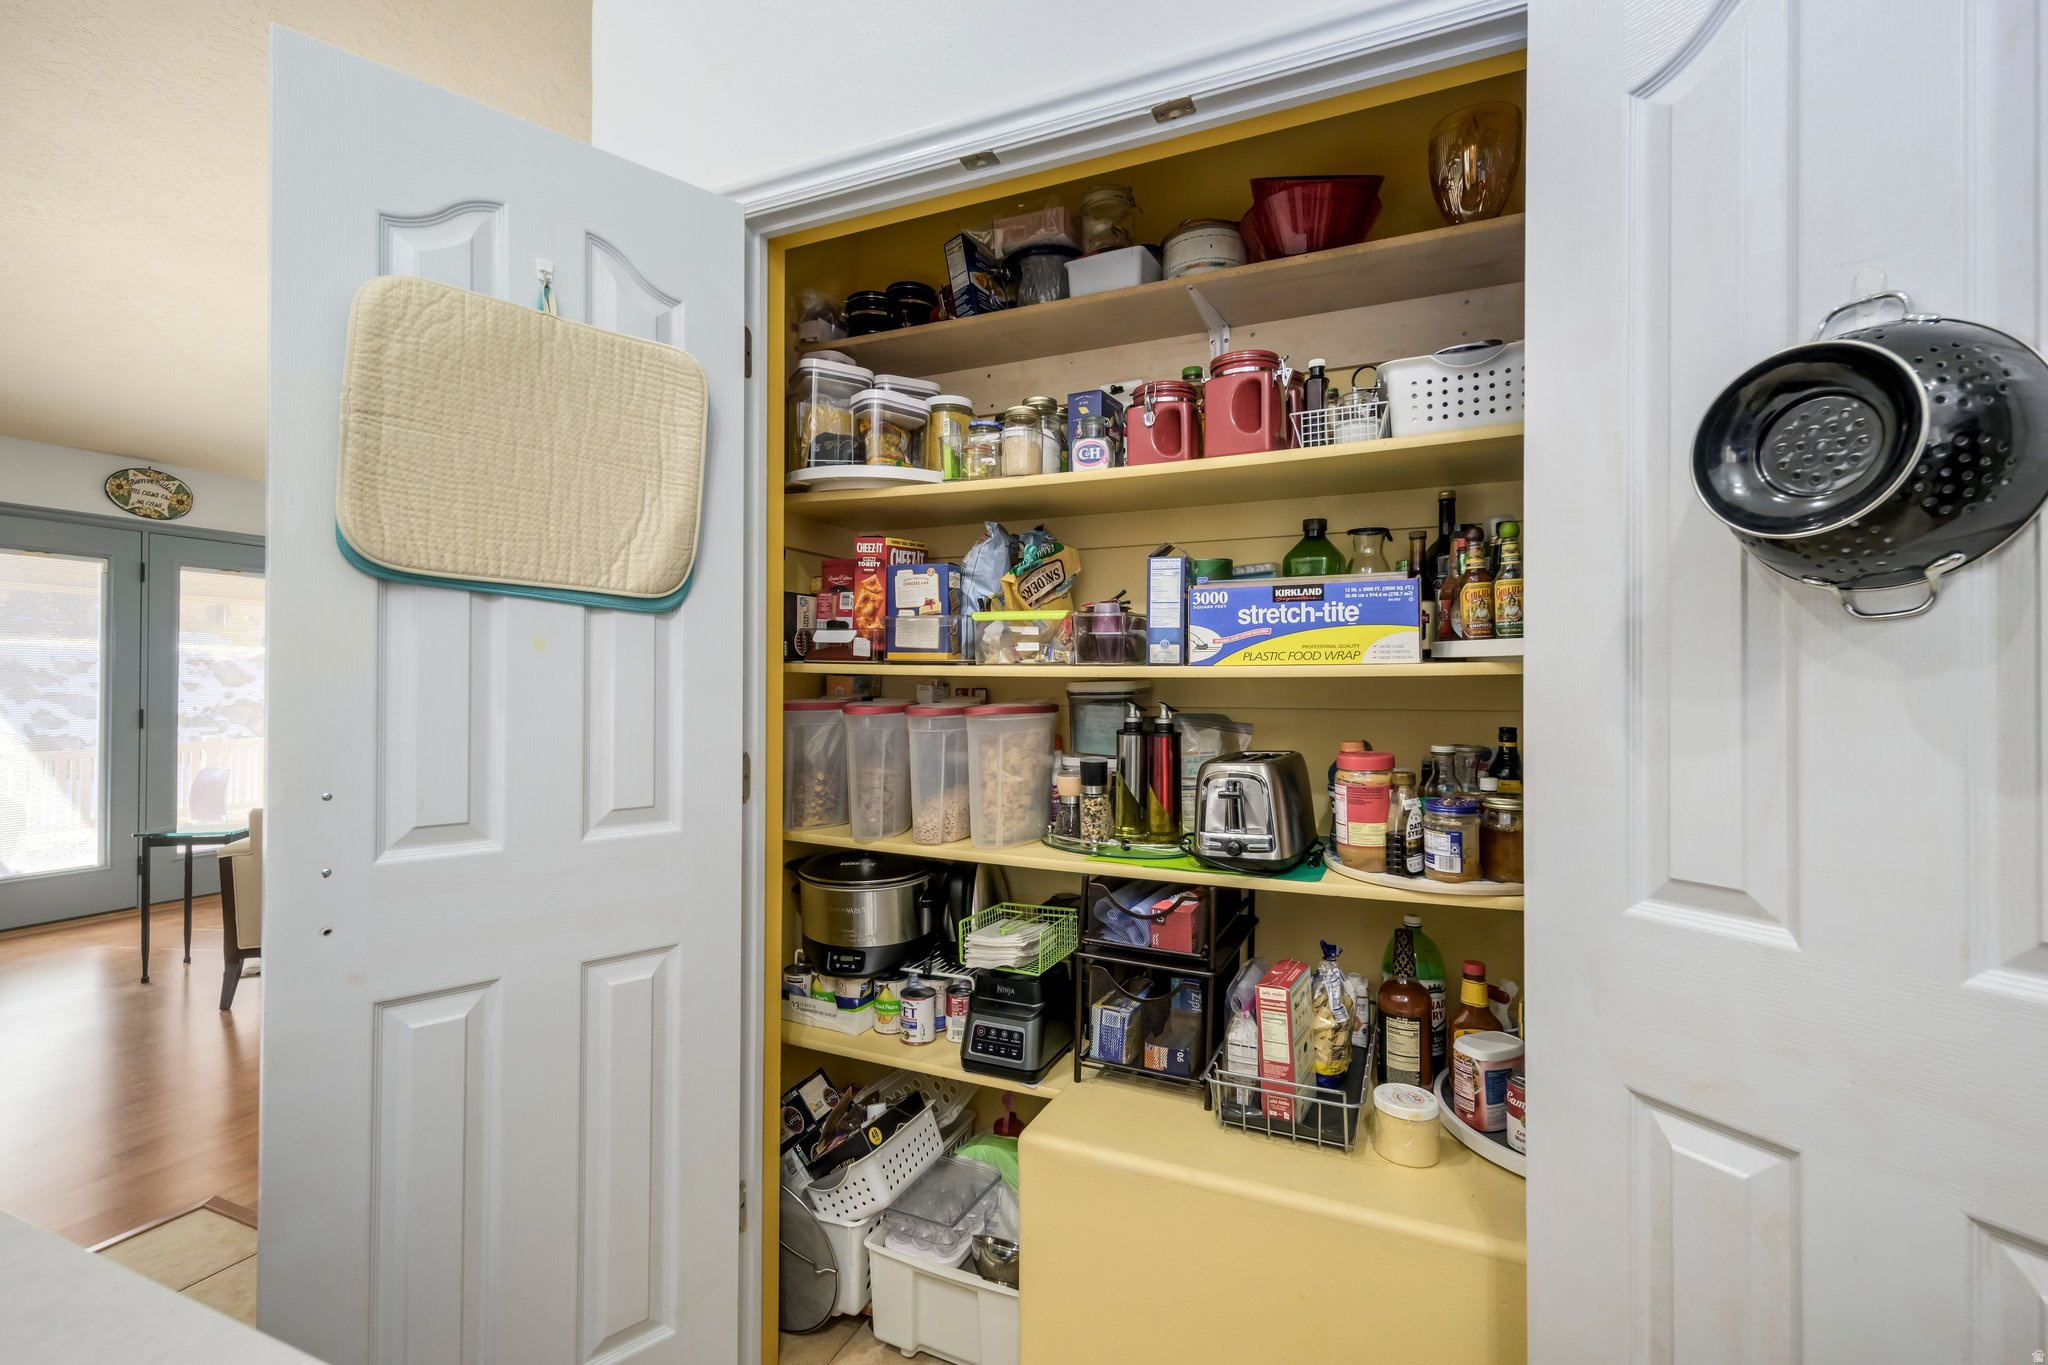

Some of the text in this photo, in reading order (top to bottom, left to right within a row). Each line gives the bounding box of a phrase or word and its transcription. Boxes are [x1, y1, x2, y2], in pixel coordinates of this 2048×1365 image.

[1079, 447, 1101, 460] C&H
[142, 490, 159, 498] casa
[145, 500, 162, 509] casa
[1021, 567, 1060, 602] SNYDER'S
[1275, 587, 1323, 597] KIRKLAND
[1192, 591, 1229, 605] 3000
[1237, 600, 1360, 625] stretch-tite
[1242, 650, 1361, 661] PLASTIC FOOD WRAP
[1410, 822, 1422, 830] DATE
[996, 984, 1015, 996] NINJA
[1188, 990, 1201, 1014] Zipl
[871, 1129, 880, 1140] 48
